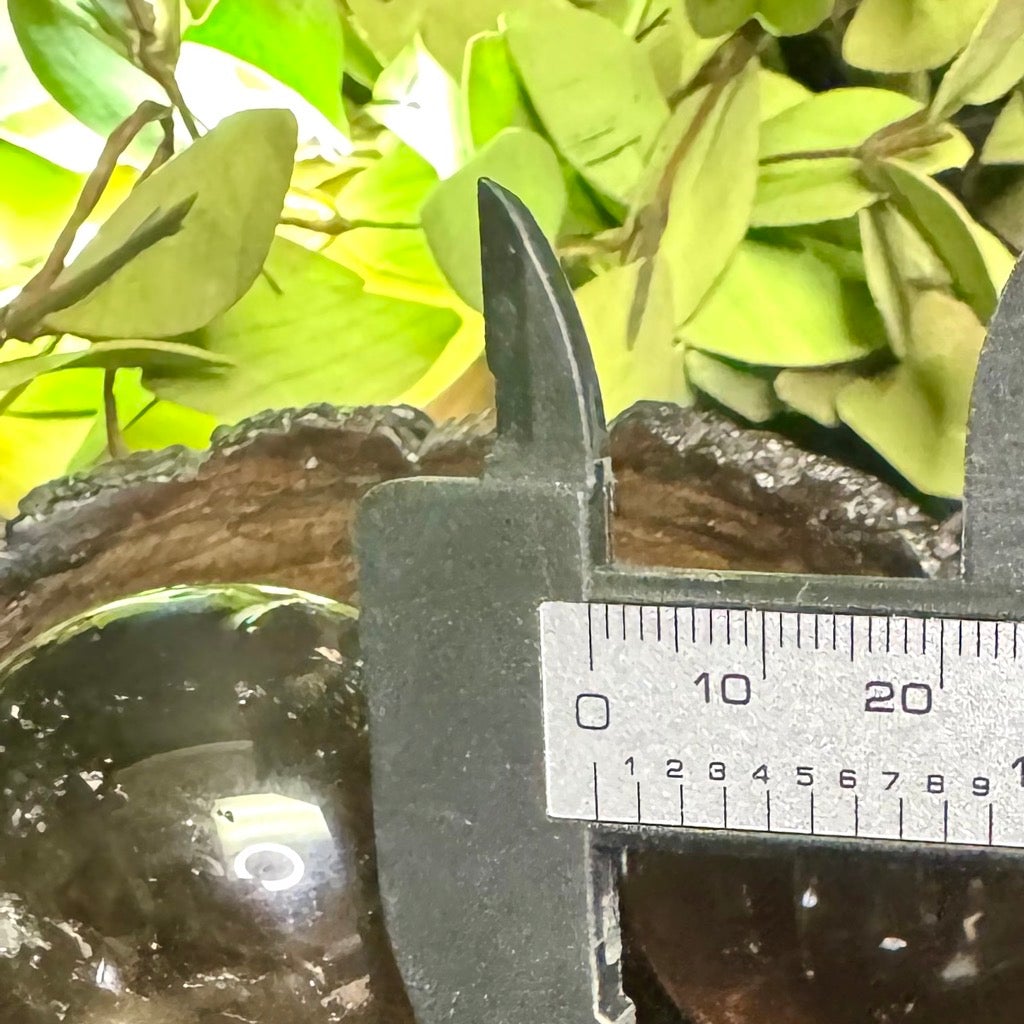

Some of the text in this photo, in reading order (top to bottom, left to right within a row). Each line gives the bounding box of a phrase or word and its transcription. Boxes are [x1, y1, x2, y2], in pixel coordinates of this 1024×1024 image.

[576, 693, 609, 729] 0
[694, 672, 751, 705] 10
[865, 681, 932, 715] 20
[624, 756, 635, 776] 1
[666, 759, 684, 779] 2
[709, 761, 726, 781] 3
[752, 764, 770, 784] 4
[797, 766, 814, 786] 5
[839, 769, 857, 789] 6
[881, 771, 900, 791] 7
[927, 774, 945, 794] 8
[972, 776, 990, 796] 9
